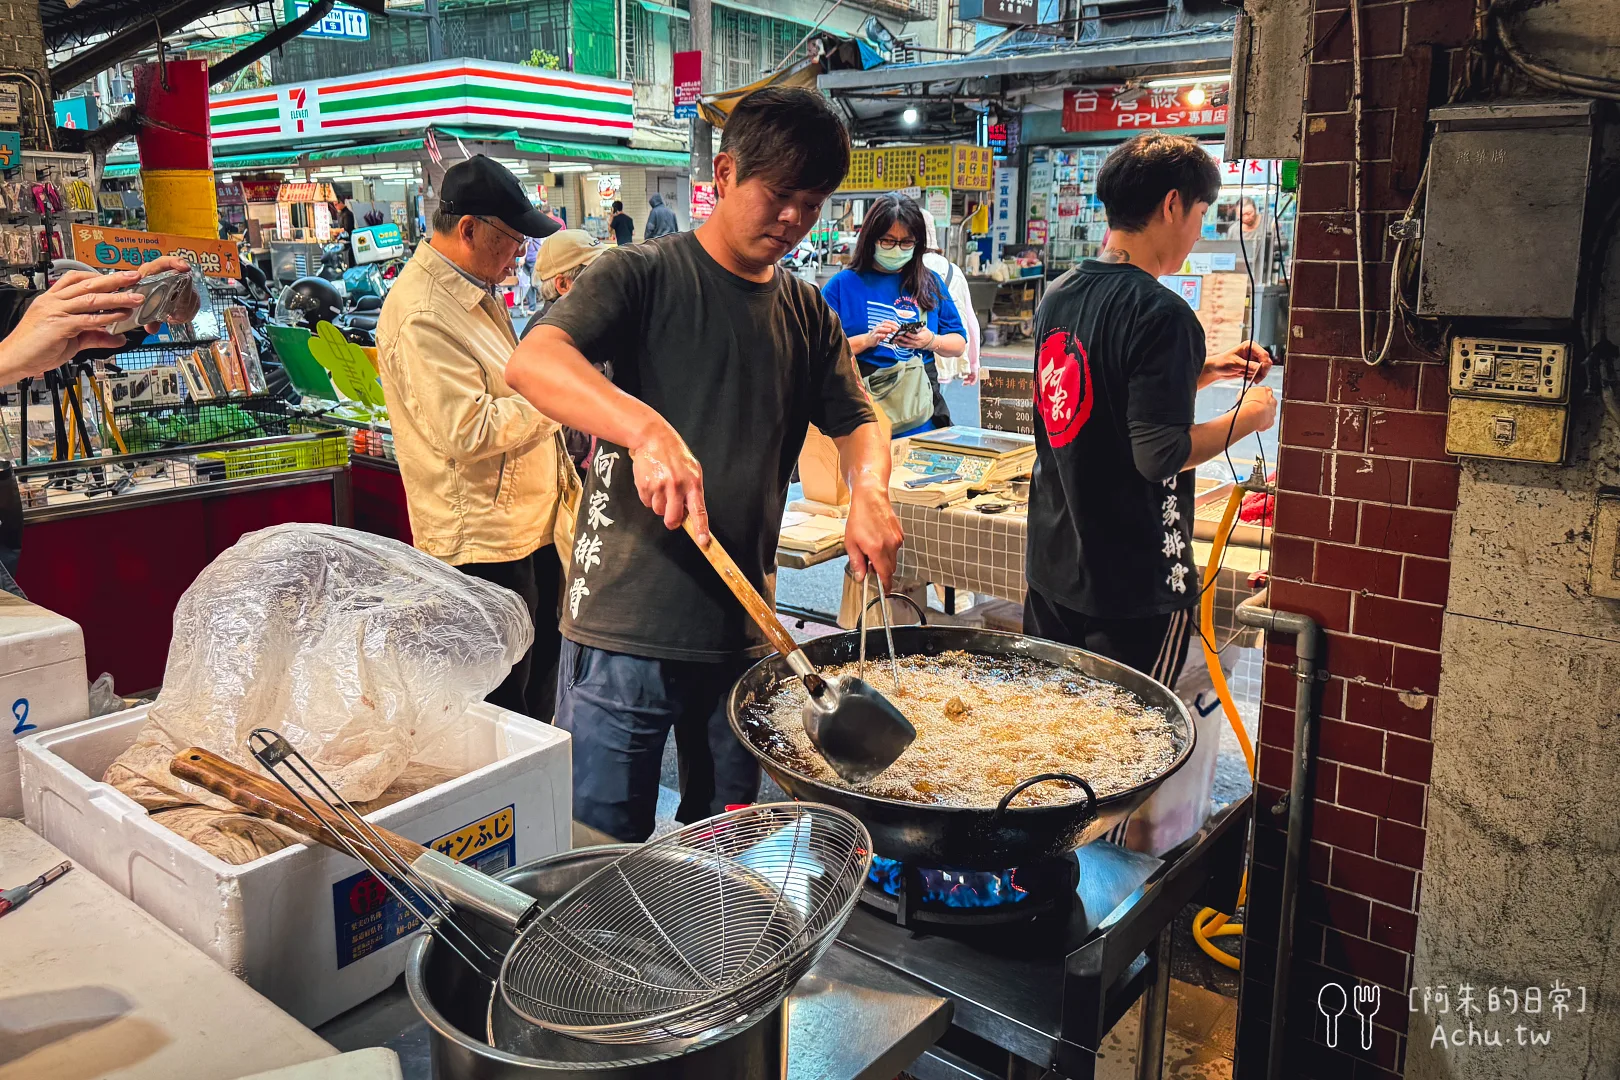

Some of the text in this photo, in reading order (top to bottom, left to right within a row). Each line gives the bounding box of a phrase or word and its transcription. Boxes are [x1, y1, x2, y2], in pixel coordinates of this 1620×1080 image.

[288, 87, 307, 133] 7
[1188, 109, 1226, 123] 專賣店
[78, 228, 105, 242] 多款
[138, 237, 160, 245] tripod
[986, 410, 1003, 420] 大份
[12, 697, 38, 735] 2
[437, 814, 510, 859] サンふじ
